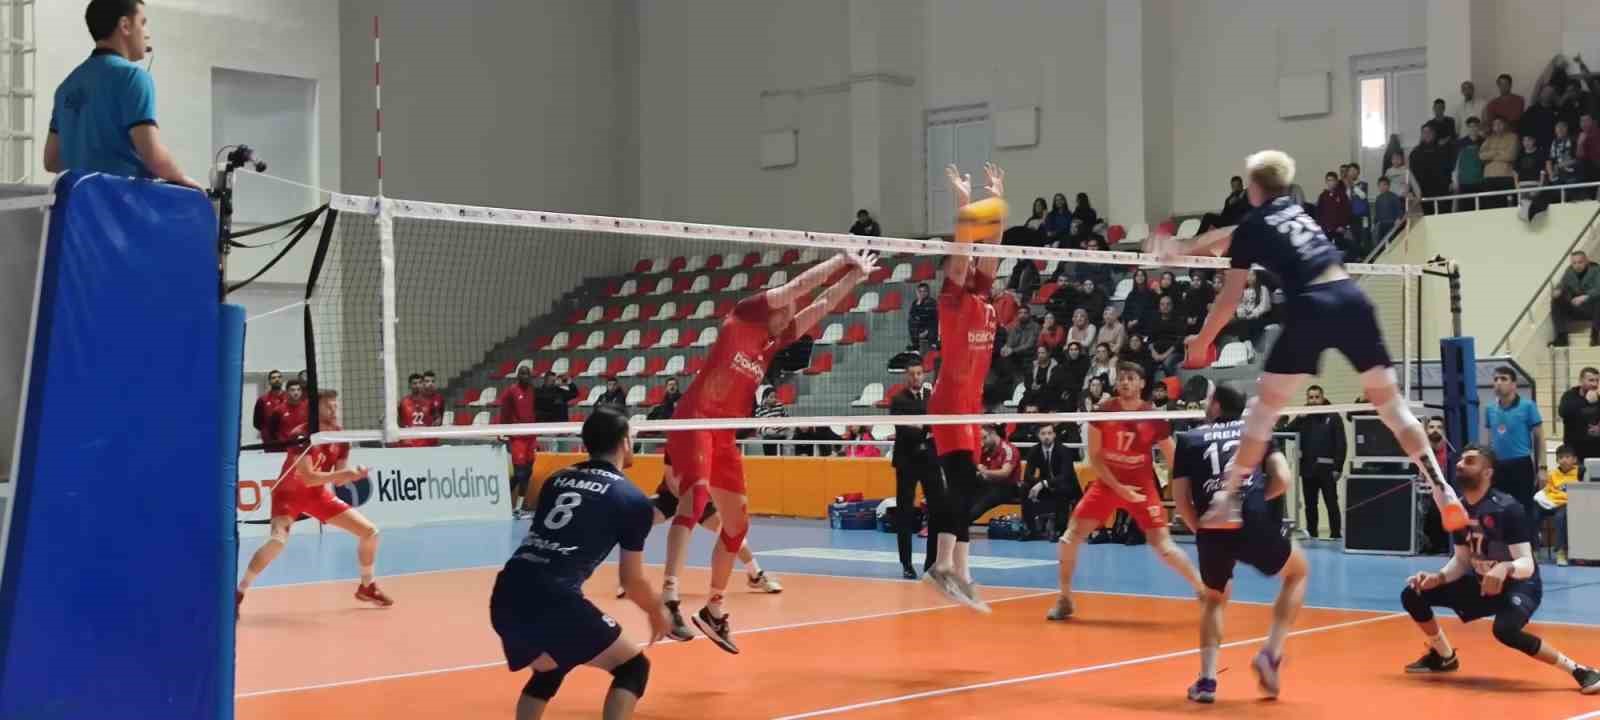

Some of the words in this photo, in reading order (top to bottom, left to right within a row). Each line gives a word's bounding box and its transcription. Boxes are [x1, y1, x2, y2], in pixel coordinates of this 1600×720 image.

[411, 411, 425, 425] 22
[1117, 431, 1137, 452] 17
[1203, 430, 1241, 441] EREN
[543, 491, 583, 530] 8
